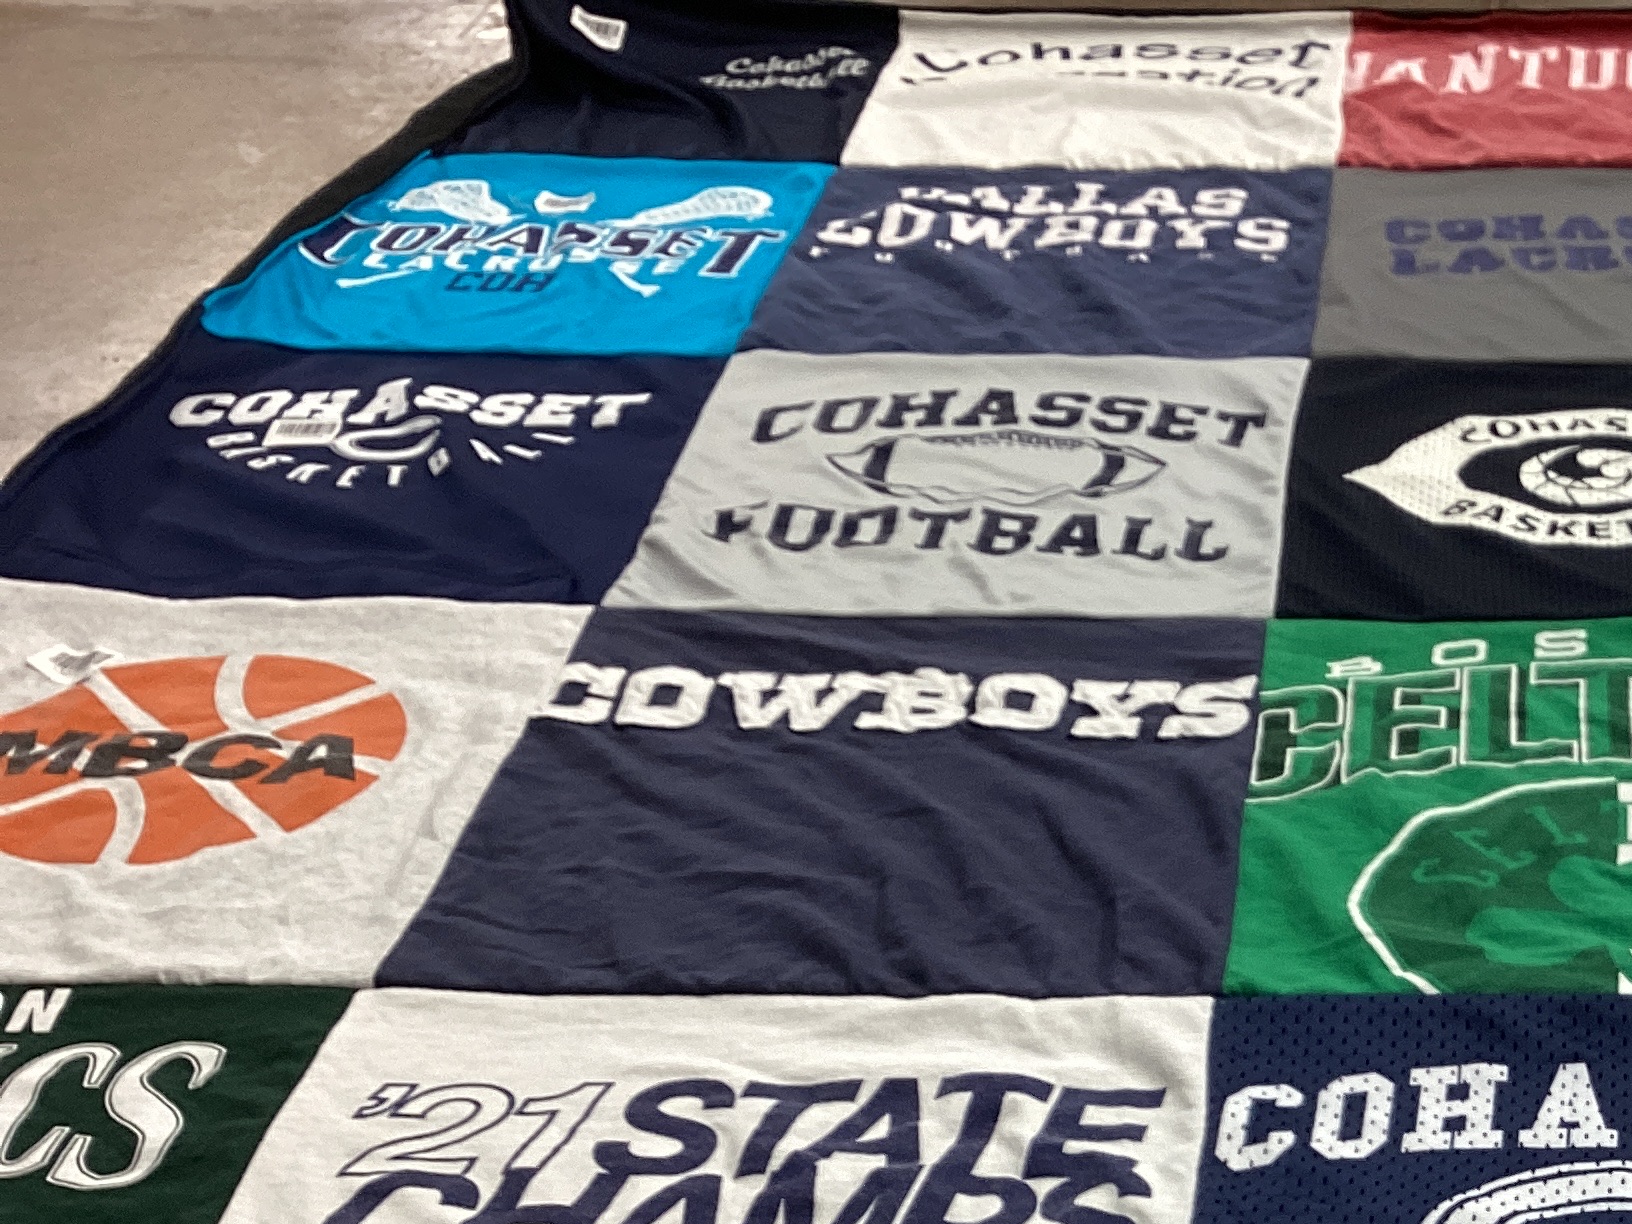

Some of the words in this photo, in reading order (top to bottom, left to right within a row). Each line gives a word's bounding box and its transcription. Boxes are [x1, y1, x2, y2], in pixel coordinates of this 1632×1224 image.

[168, 377, 653, 428] COHASSET
[751, 387, 1267, 448] COHASSET
[702, 501, 1230, 562] FOOTBALL
[528, 662, 1258, 739] COWBOYS
[0, 730, 356, 784] MBCA
[0, 988, 72, 1033] N
[0, 1042, 228, 1189] CS
[591, 1073, 1167, 1181] STATE
